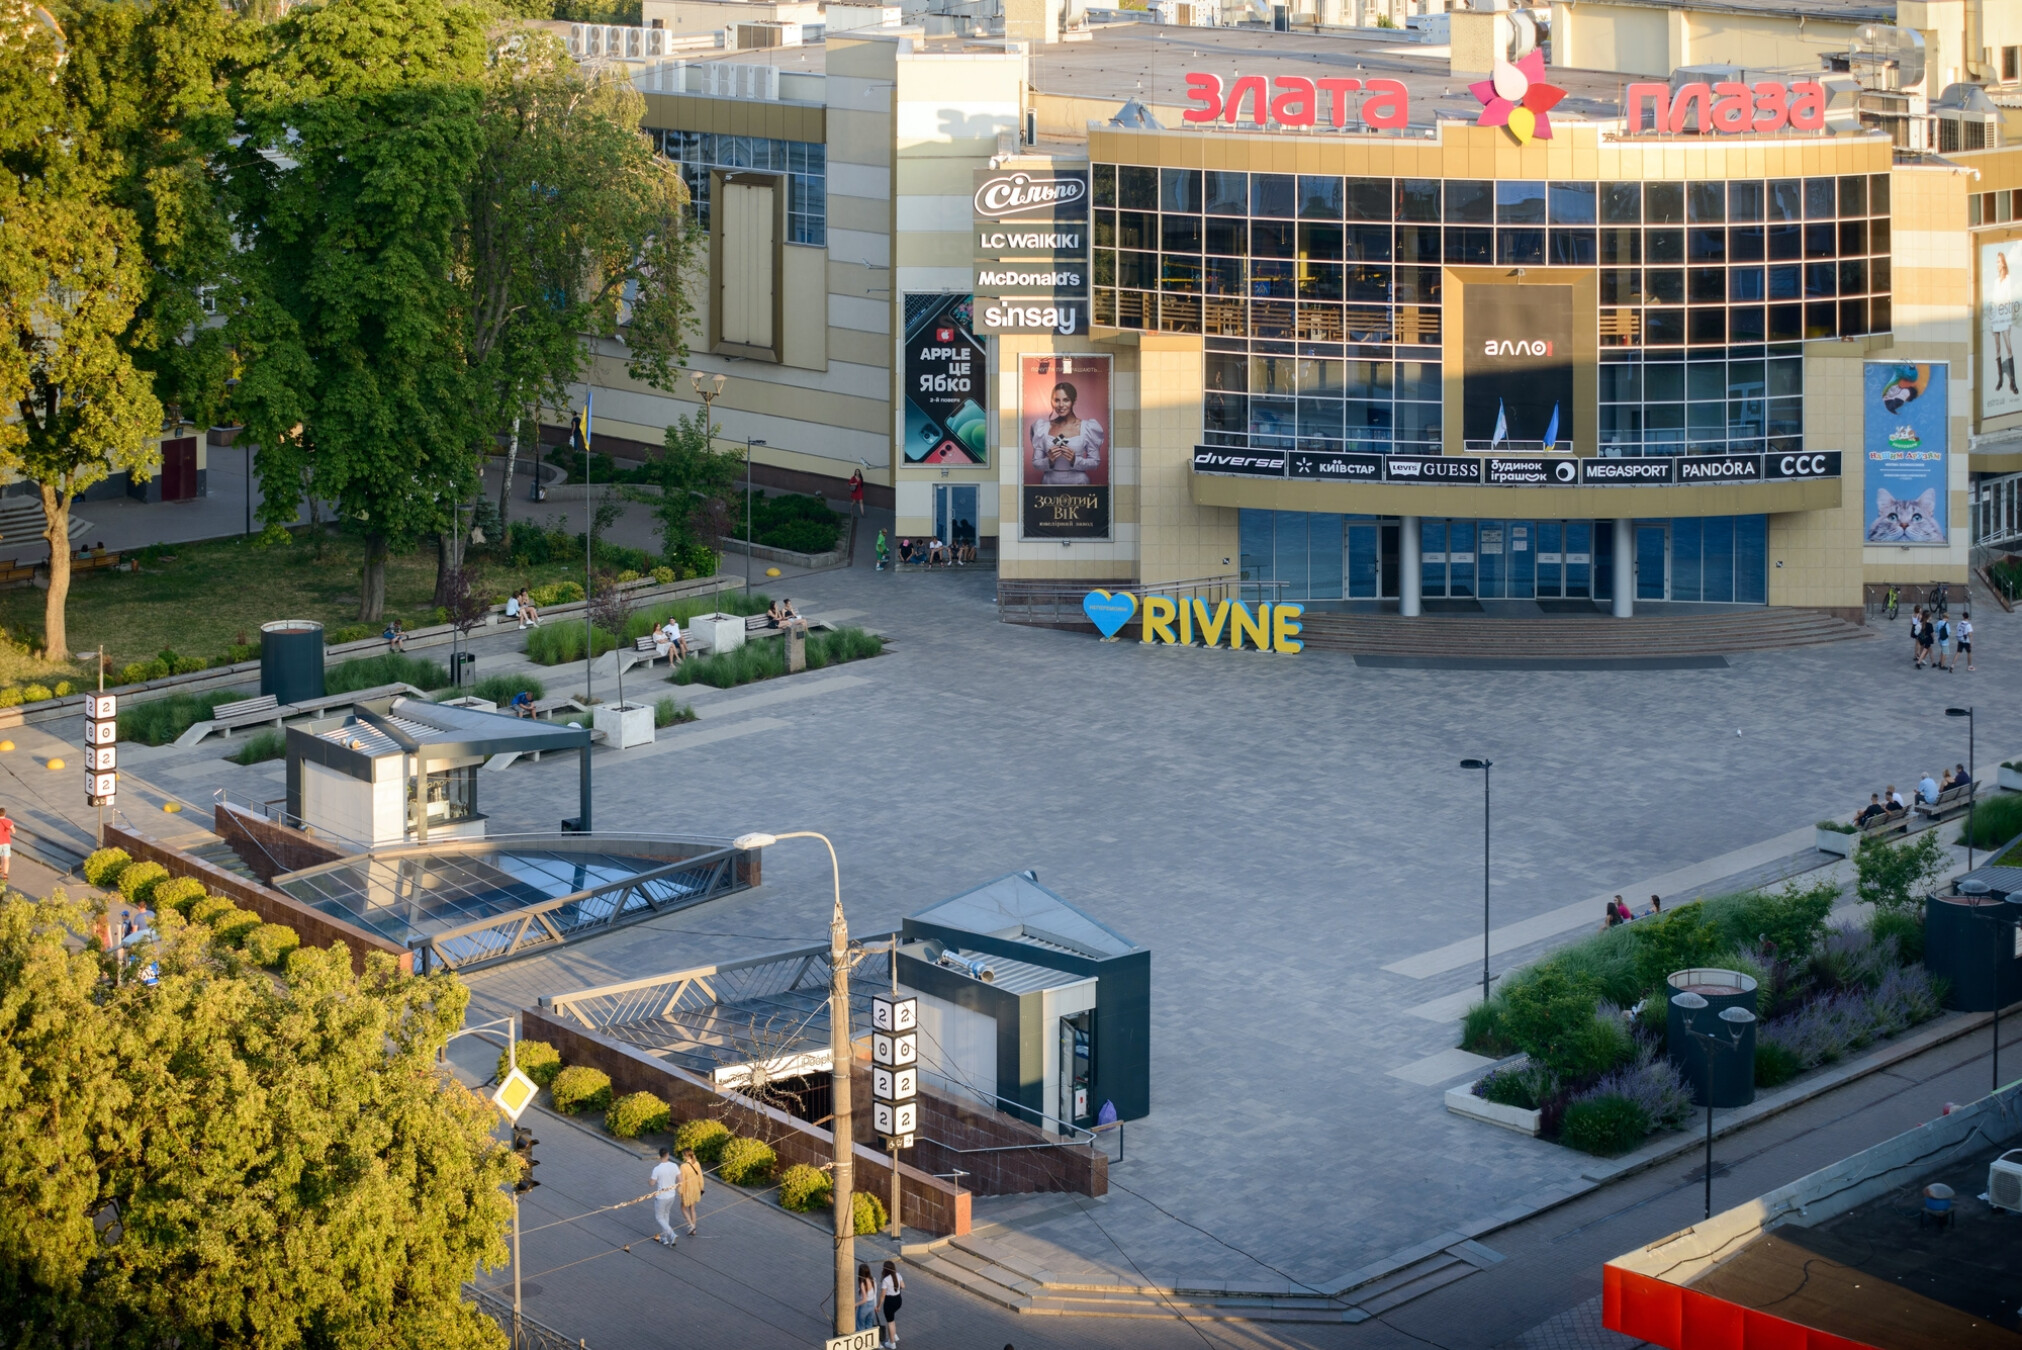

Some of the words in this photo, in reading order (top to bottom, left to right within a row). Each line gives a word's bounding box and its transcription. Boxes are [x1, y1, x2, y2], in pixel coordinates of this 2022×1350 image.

[984, 176, 1078, 209] Сільпо
[980, 233, 1005, 248] LC
[978, 271, 1081, 286] McDonald's
[984, 300, 1076, 335] sinsay
[920, 347, 971, 360] APPLE
[949, 363, 971, 376] ЦЕ
[920, 373, 971, 392] Ябко
[1194, 452, 1285, 469] diverse
[1318, 459, 1376, 475] КИЇВСТАР
[1490, 459, 1543, 471] будинок
[1682, 459, 1756, 477] PANDORA
[1780, 454, 1827, 475] CCC
[1423, 463, 1479, 477] GUESS
[1586, 464, 1668, 478] MEGASPORT
[1054, 506, 1080, 520] ВІК
[1142, 594, 1305, 654] RIVNE
[833, 1333, 874, 1350] СТОП
